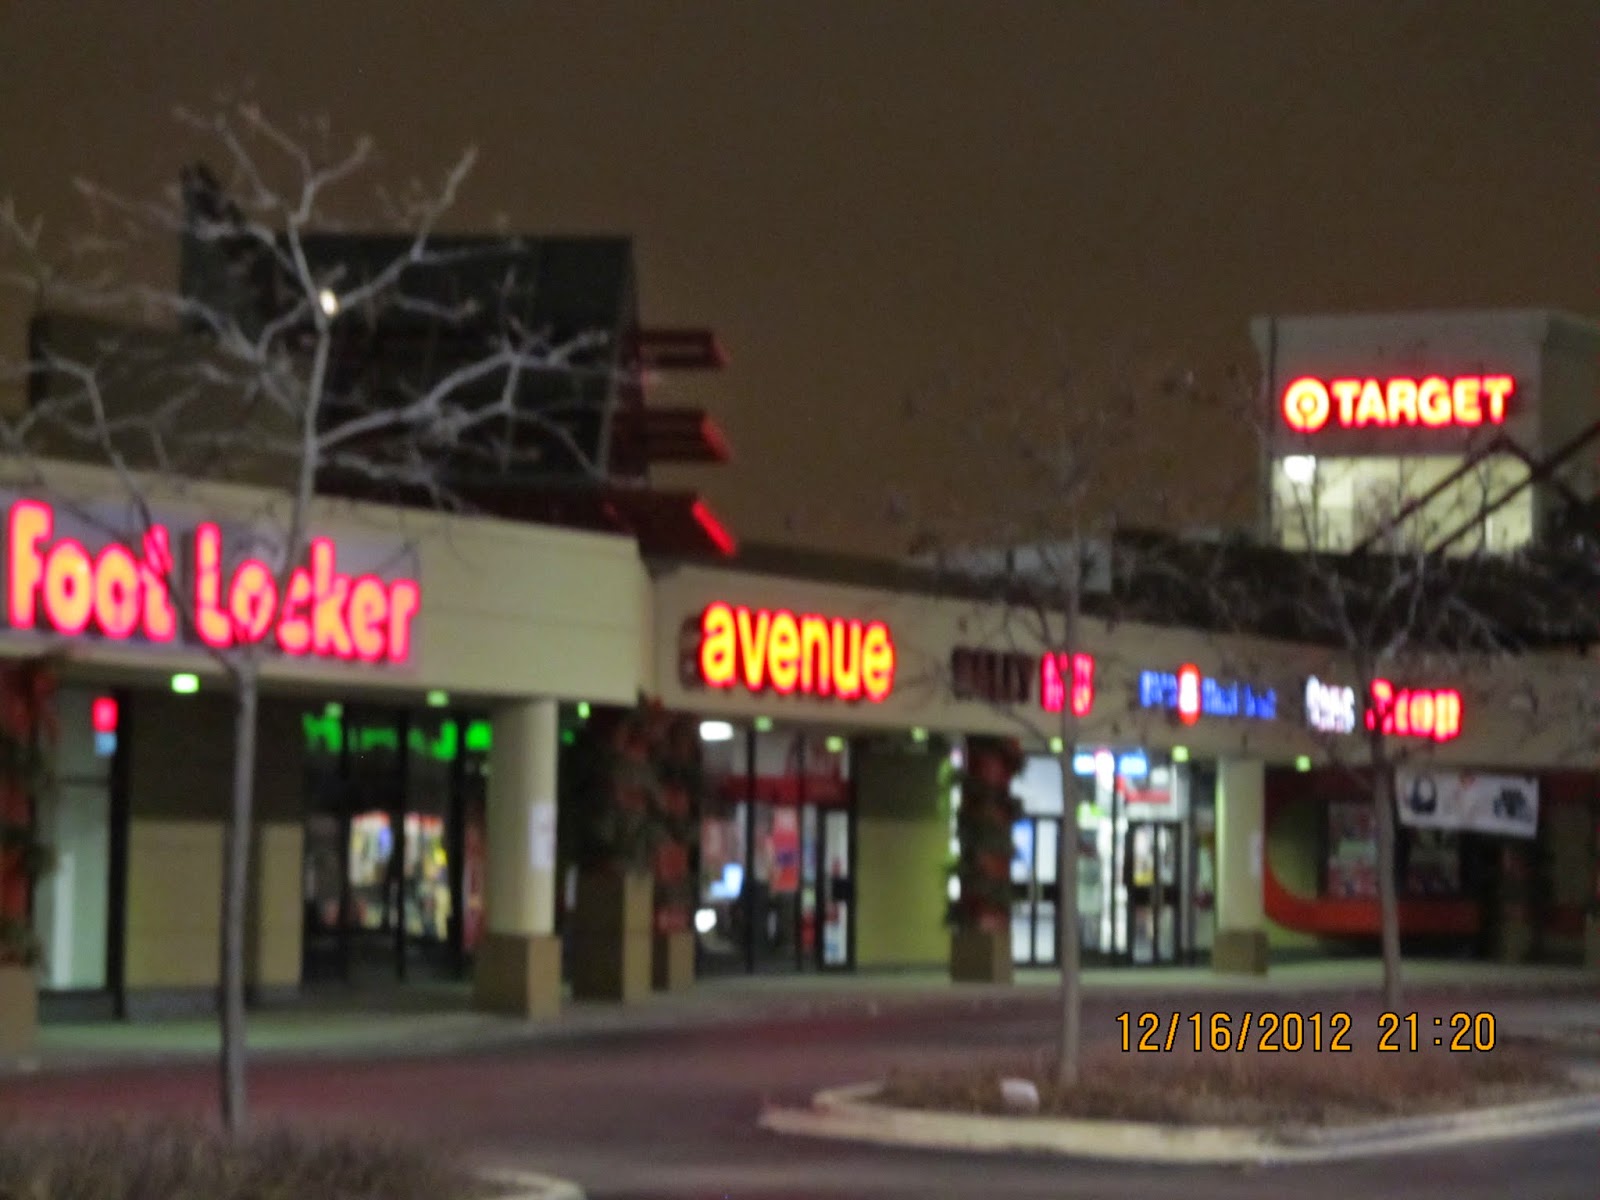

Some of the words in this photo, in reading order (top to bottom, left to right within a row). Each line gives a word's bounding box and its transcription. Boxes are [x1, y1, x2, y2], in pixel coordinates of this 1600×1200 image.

[1330, 375, 1515, 428] TARGET
[9, 500, 176, 643] Foot
[195, 521, 420, 664] Locker
[701, 600, 895, 703] avenue
